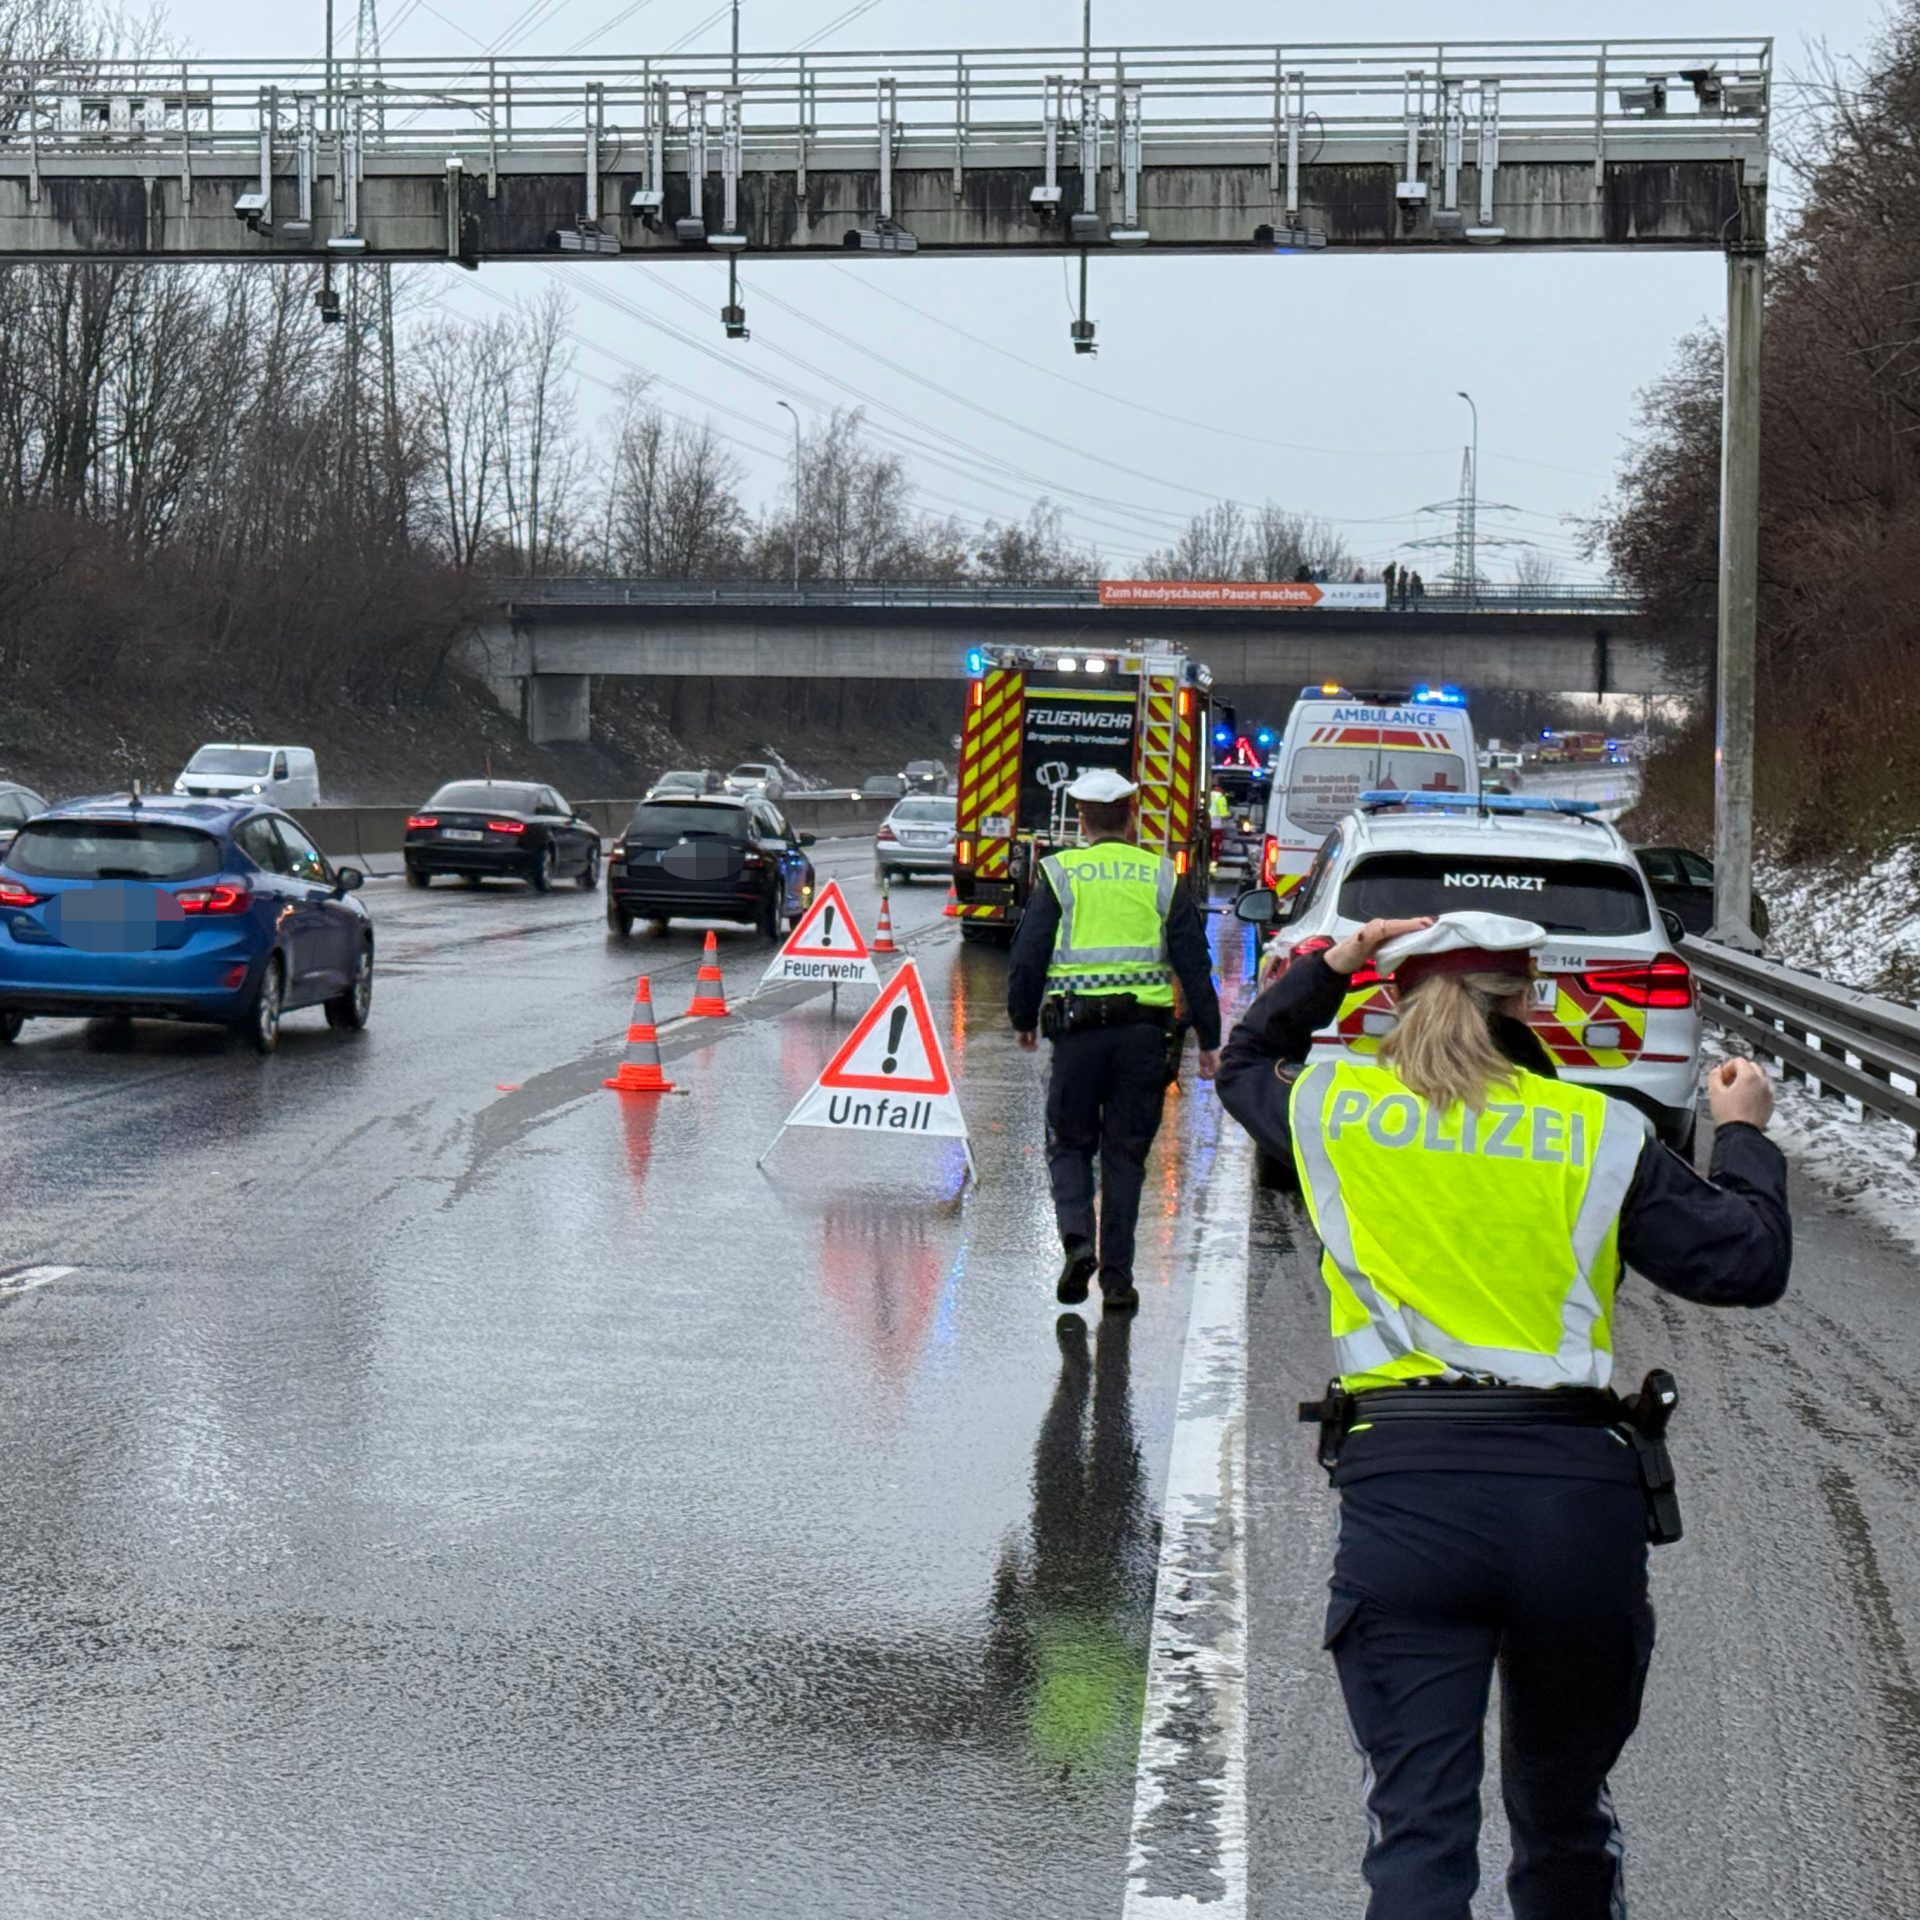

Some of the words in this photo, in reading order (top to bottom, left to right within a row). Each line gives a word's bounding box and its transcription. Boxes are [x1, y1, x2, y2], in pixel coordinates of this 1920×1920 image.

[1105, 586, 1131, 598] Zum
[1133, 586, 1219, 601] Handyschauen
[1222, 588, 1257, 600] Pause
[1025, 709, 1133, 729] FEUERWEHR
[1333, 708, 1436, 726] AMBULANCE
[1443, 873, 1546, 891] NOTARZT
[784, 960, 865, 979] Feuerwehr
[1561, 956, 1582, 967] 144
[828, 1095, 932, 1130] Unfall
[1328, 1090, 1584, 1167] POLIZEI
